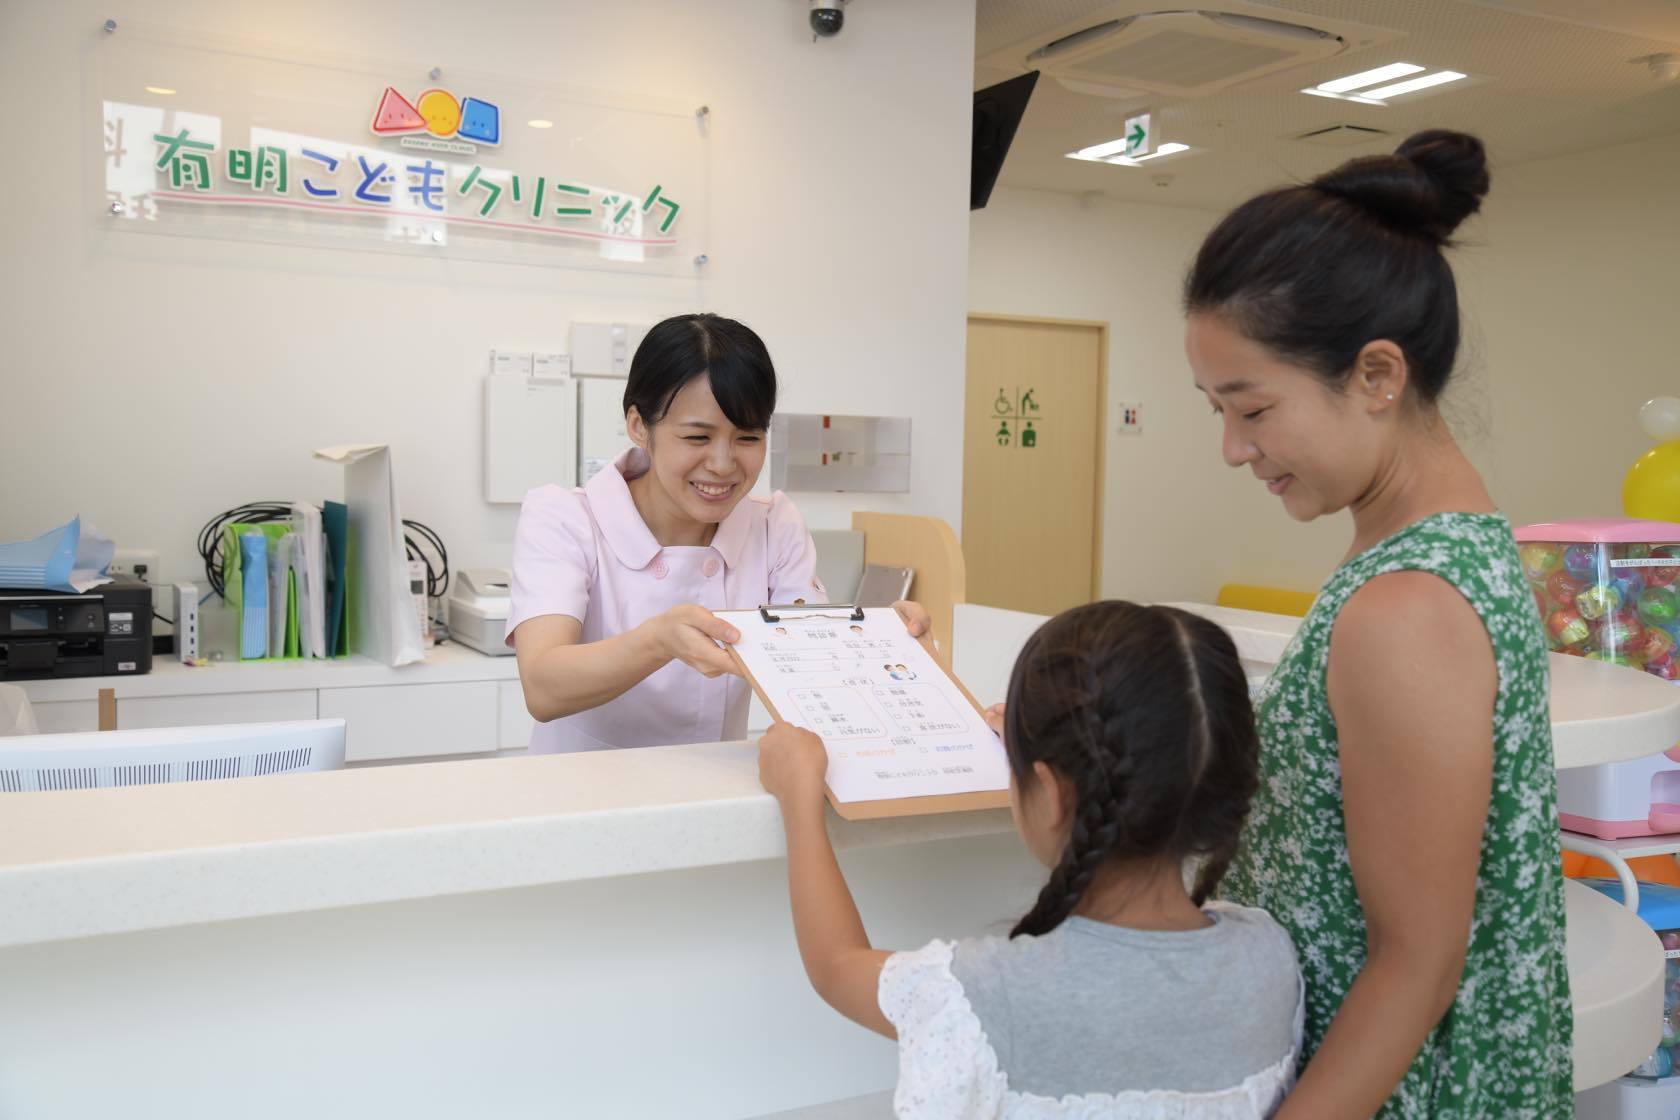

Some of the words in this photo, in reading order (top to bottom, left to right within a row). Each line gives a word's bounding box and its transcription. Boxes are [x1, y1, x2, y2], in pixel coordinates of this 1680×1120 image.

[153, 130, 680, 232] 有明こどもクリニック
